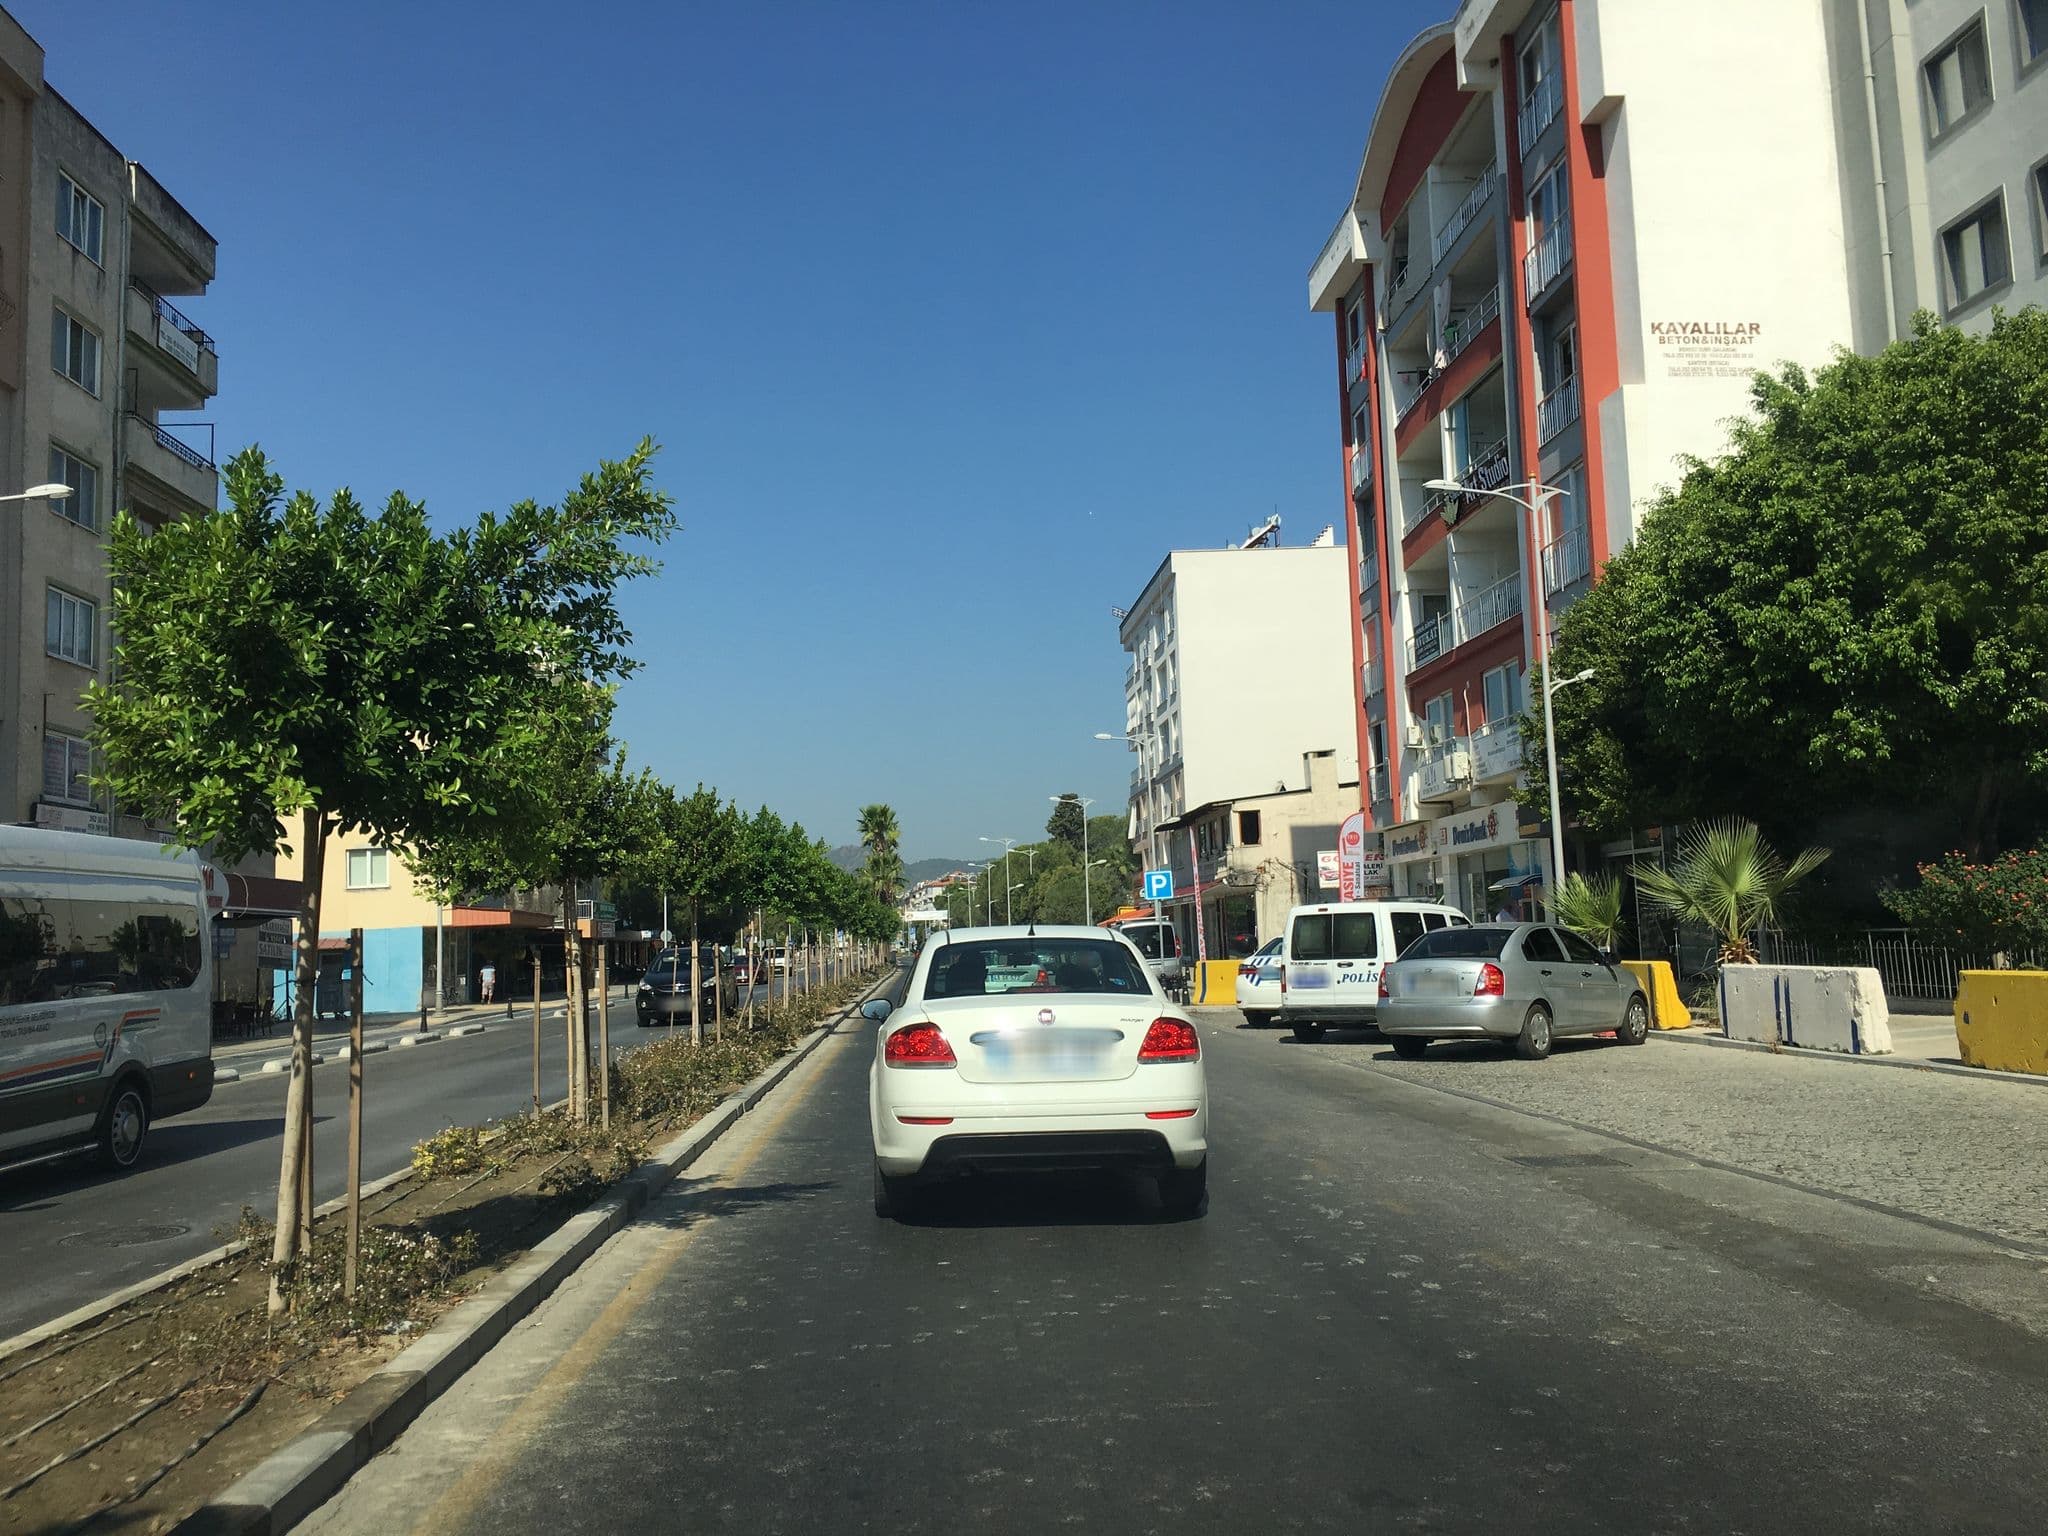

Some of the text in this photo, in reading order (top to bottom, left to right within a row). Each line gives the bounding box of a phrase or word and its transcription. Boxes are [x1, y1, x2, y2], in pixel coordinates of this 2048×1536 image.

[1651, 322, 1761, 335] KAYALILAR
[1463, 475, 1480, 504] Art
[1477, 454, 1509, 490] Studio
[1151, 875, 1167, 896] P
[1342, 970, 1379, 983] POLİS
